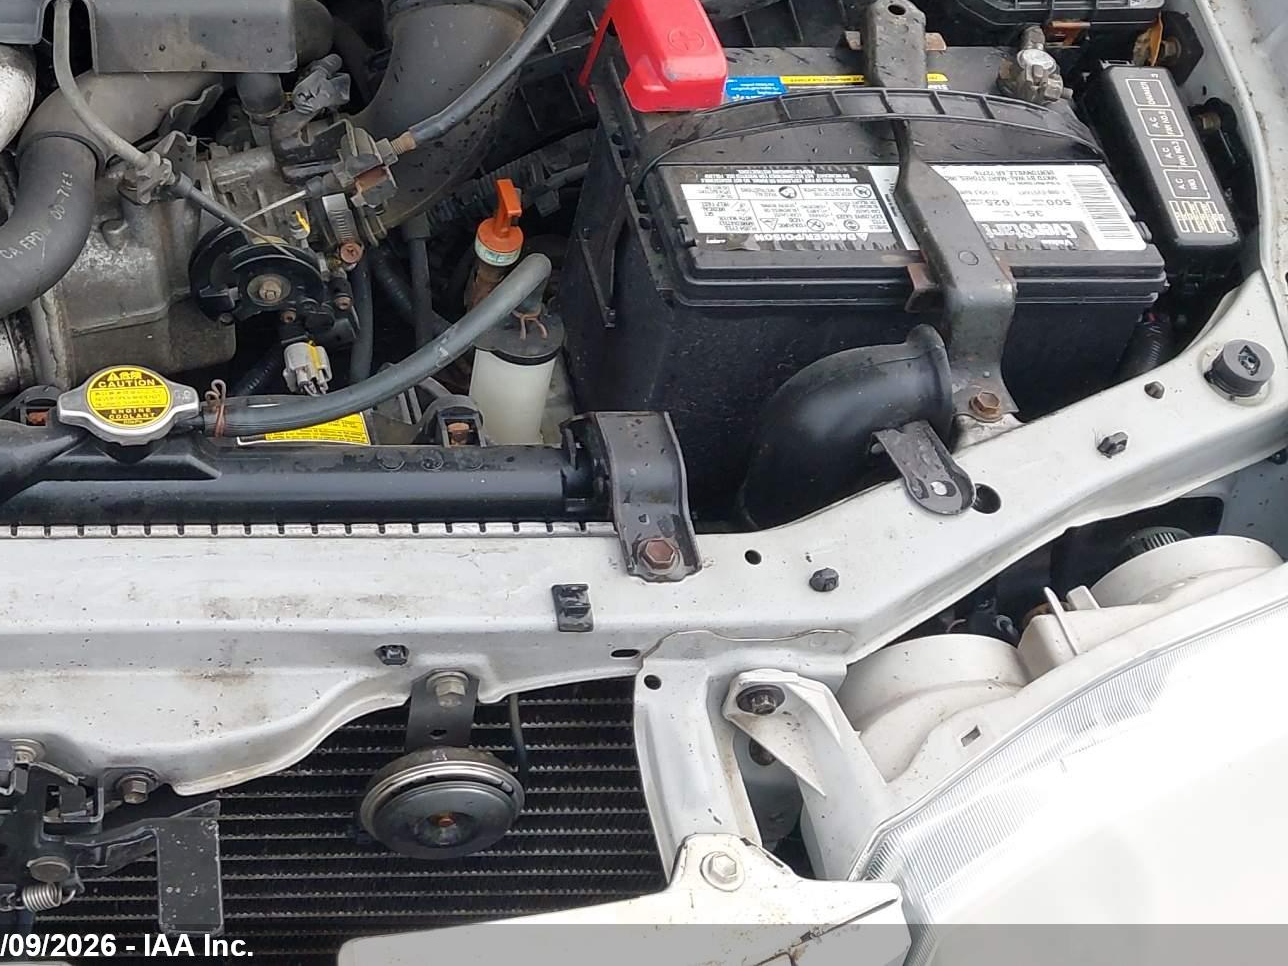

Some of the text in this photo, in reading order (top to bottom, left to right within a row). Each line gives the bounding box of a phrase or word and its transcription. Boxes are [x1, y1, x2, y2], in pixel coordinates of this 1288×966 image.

[981, 223, 1079, 239] EverStart
[98, 379, 156, 388] CAUTION
[109, 412, 156, 420] COOLANT
